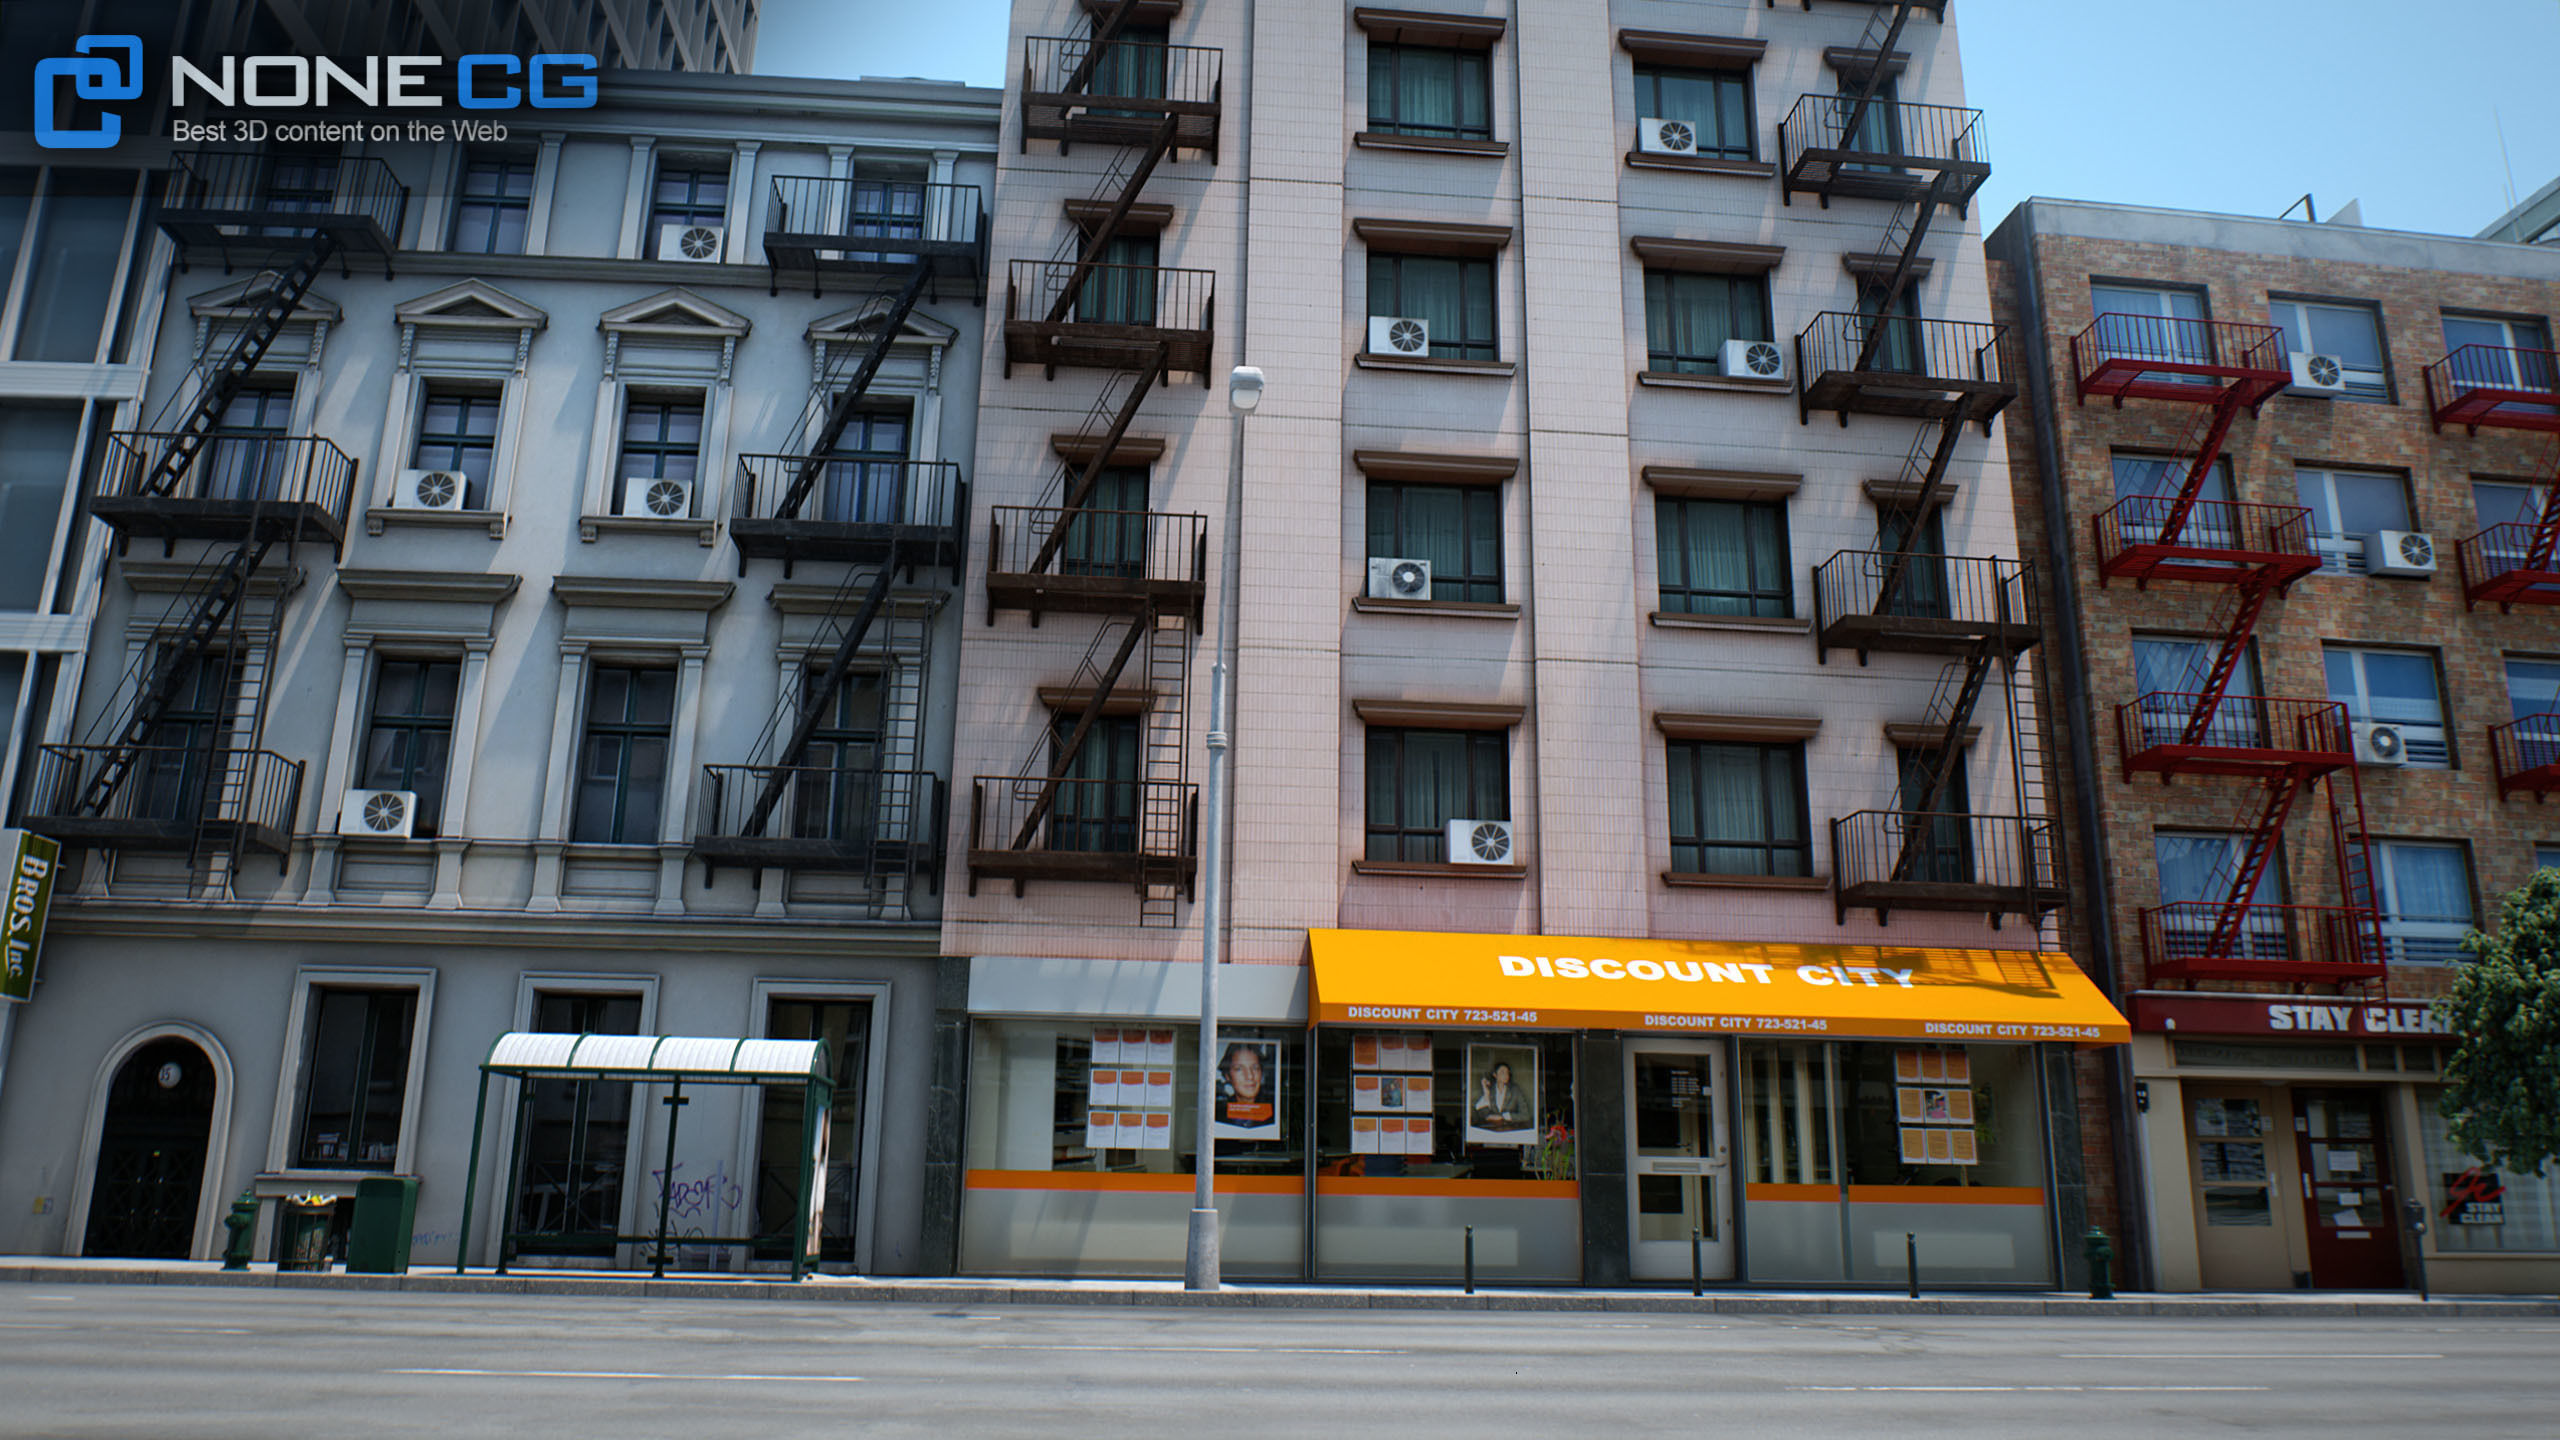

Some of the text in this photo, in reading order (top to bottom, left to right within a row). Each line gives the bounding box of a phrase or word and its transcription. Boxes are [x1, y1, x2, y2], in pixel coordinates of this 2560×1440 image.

[1497, 955, 1915, 989] DISCOUNT CITY
[1348, 1006, 1538, 1023] DISCOUNT CITY 723-521-45
[1644, 1014, 1828, 1031] DISCOUNT CITY 723-521-45
[2269, 1004, 2353, 1032] STAY
[1924, 1022, 2100, 1038] DISCOUNT CITY 723-521-45
